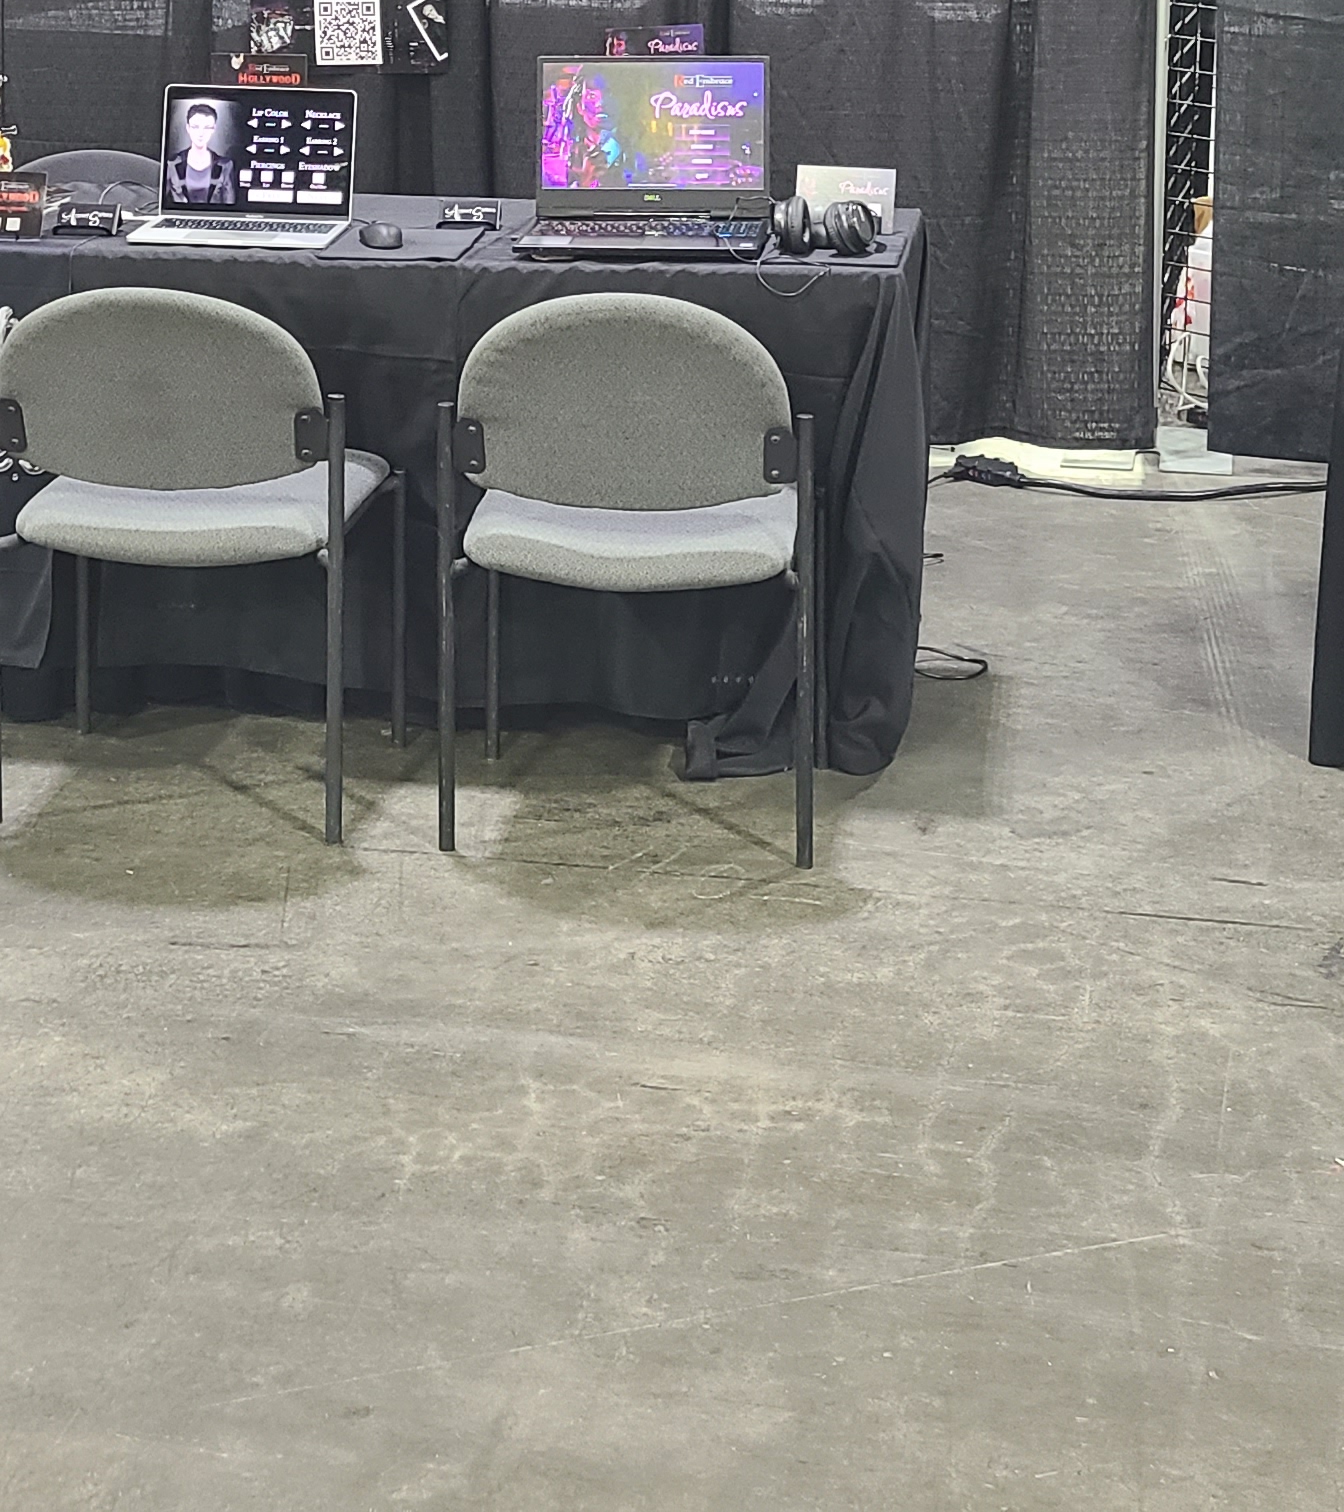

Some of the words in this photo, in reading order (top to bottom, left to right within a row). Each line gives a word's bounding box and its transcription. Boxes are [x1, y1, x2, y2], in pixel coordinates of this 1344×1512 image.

[237, 72, 301, 85] HOLLYWOOD
[674, 74, 695, 88] Red
[695, 74, 734, 88] Embrace
[649, 90, 748, 120] Paradisus
